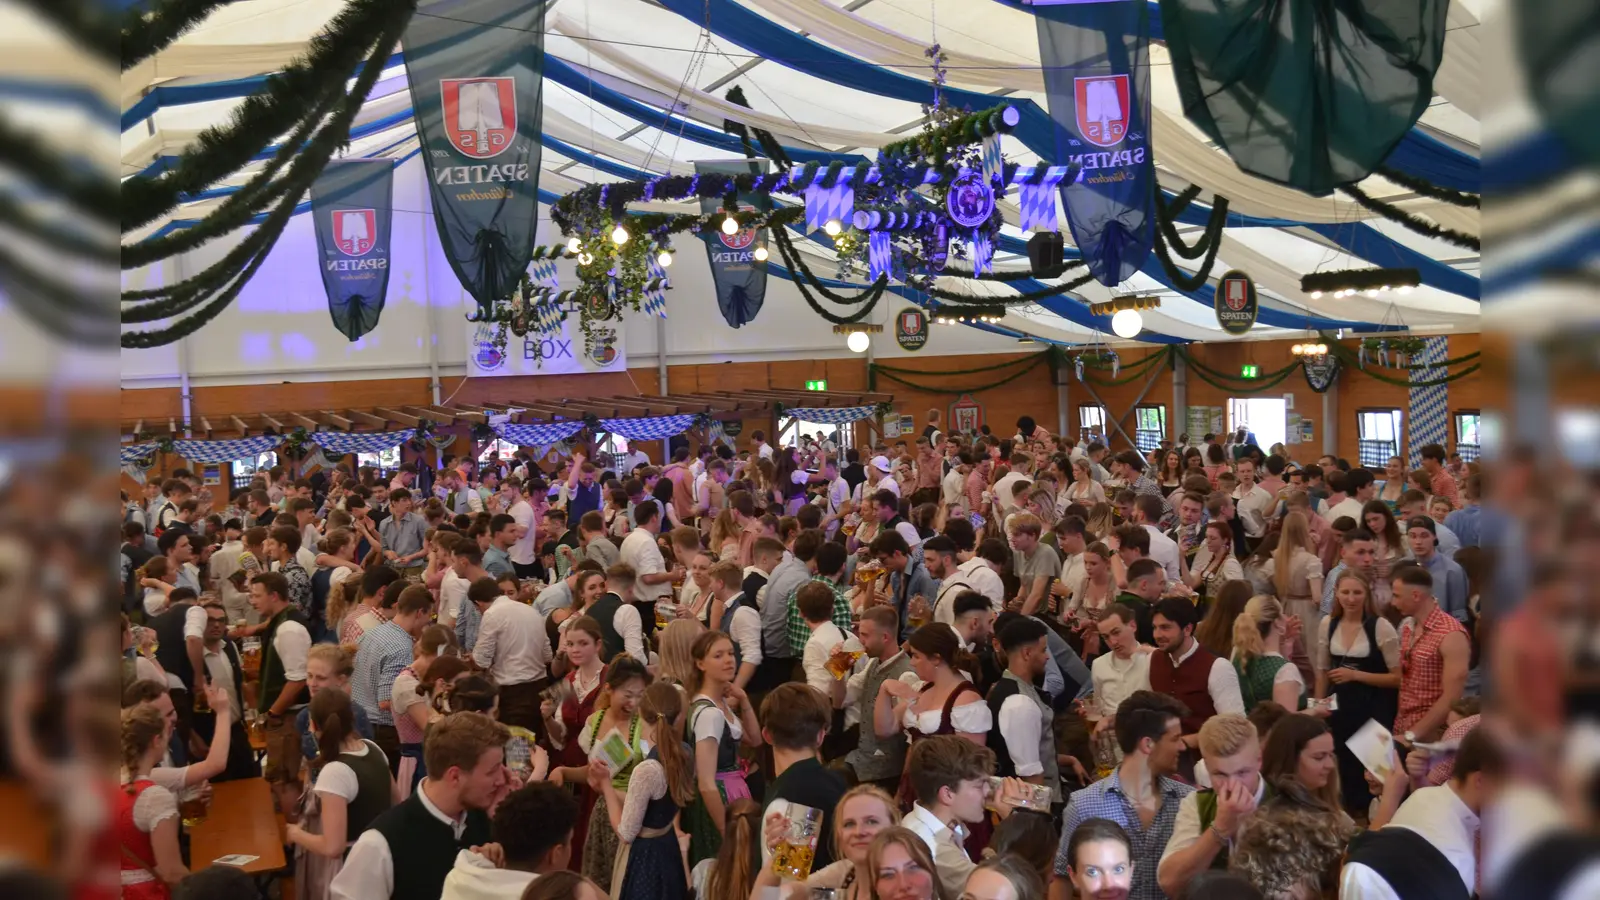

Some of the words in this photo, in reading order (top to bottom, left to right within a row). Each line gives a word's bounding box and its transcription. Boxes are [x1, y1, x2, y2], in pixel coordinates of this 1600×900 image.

[1220, 311, 1253, 320] SPATEN
[899, 335, 925, 343] SPATEN
[523, 339, 573, 360] BOX
